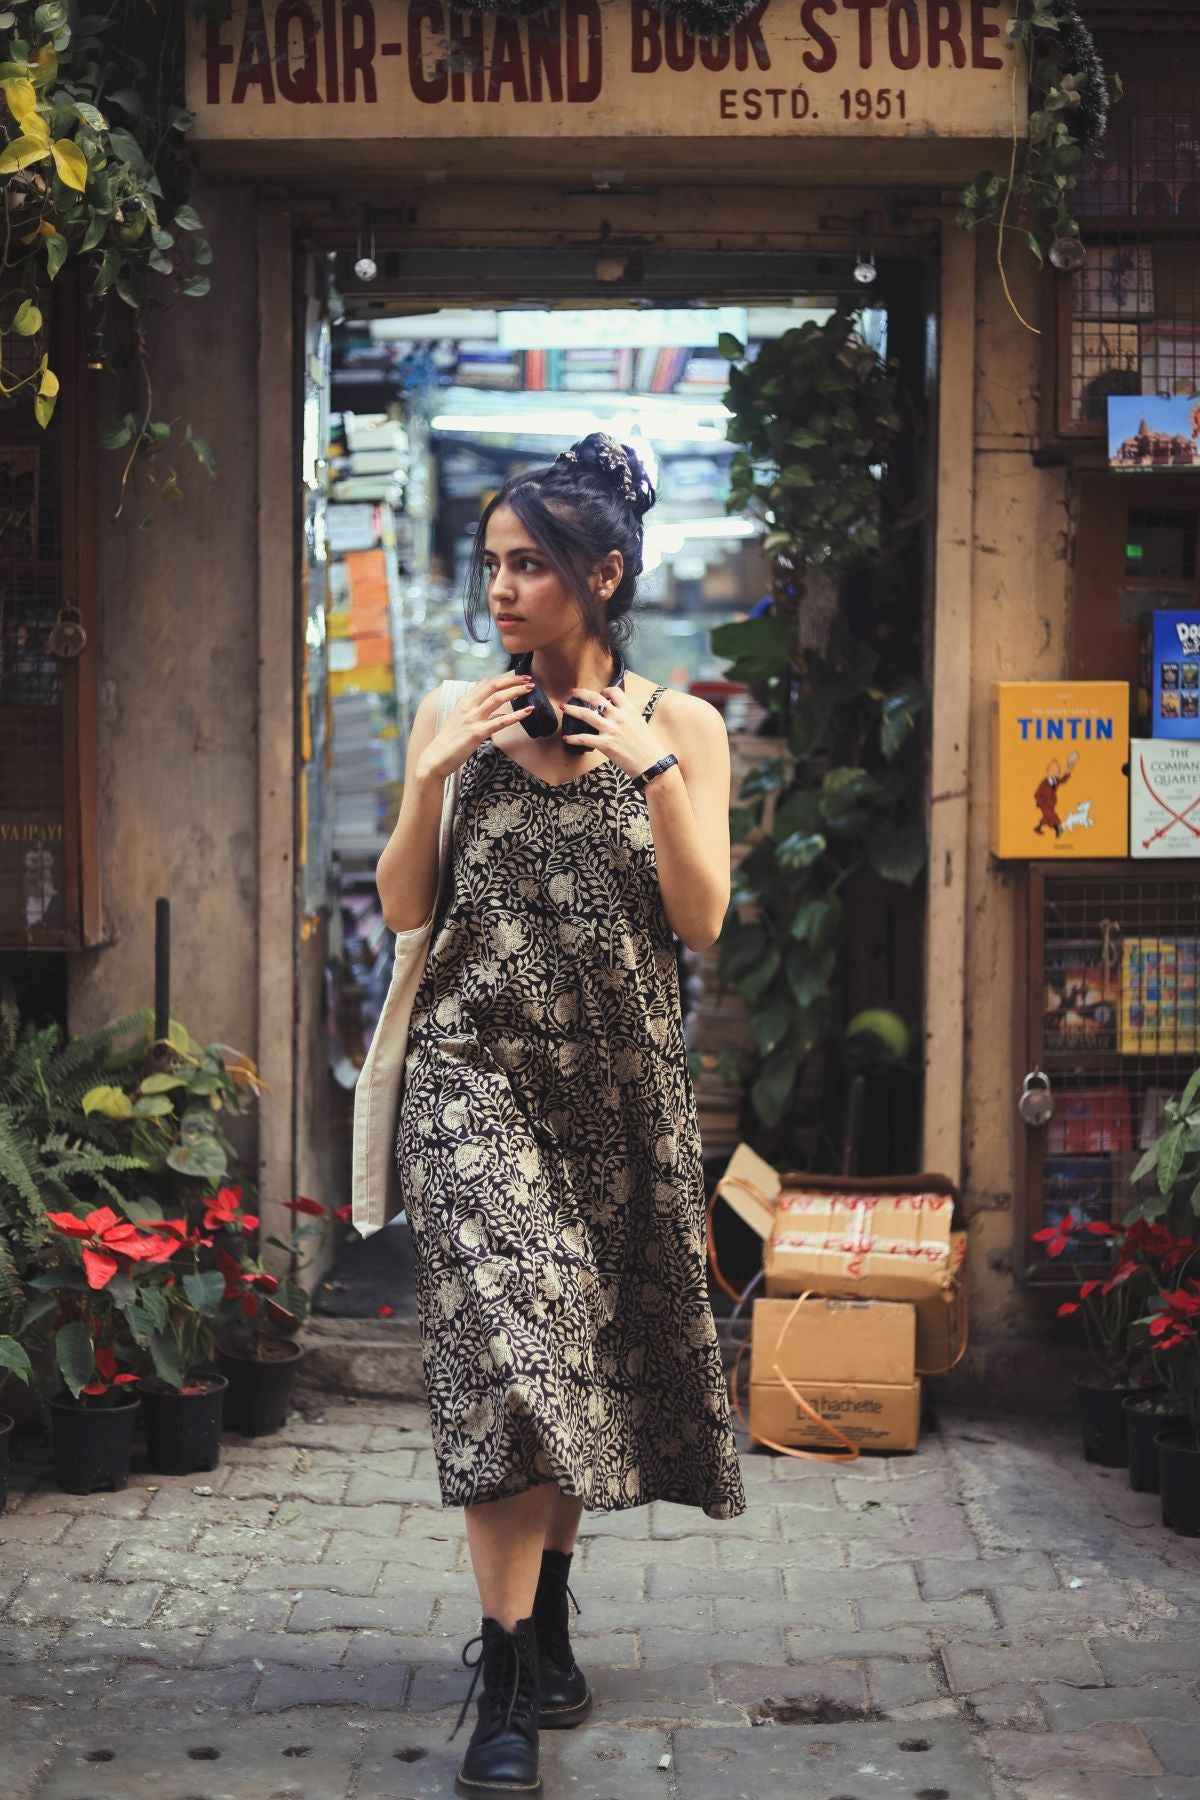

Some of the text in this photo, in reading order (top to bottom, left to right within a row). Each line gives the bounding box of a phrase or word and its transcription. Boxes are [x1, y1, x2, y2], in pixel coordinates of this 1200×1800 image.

[800, 0, 1004, 74] STORE
[719, 86, 907, 121] ESTD. 1951
[1017, 718, 1114, 741] TINTIN
[1151, 761, 1200, 772] COMPAN
[1154, 775, 1200, 786] QUARTE
[821, 1395, 884, 1414] hachette
